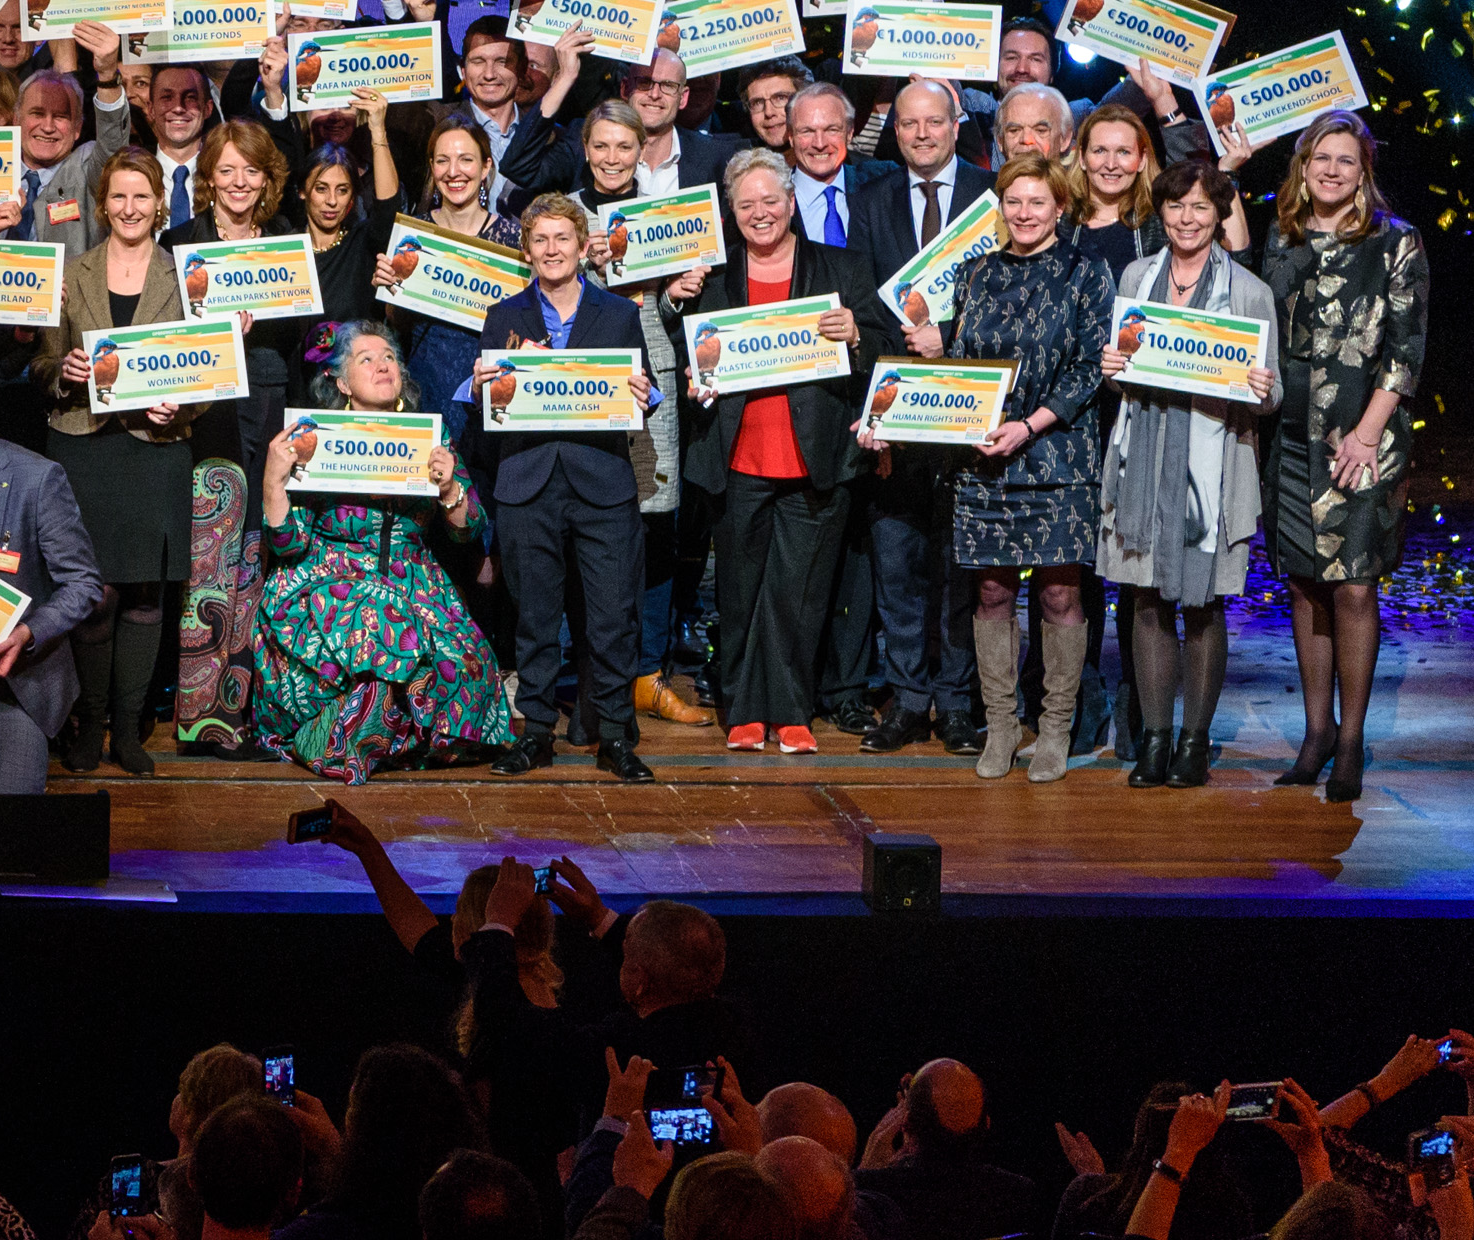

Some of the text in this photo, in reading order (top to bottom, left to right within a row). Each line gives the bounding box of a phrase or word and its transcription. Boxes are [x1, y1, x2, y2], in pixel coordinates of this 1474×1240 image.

[679, 7, 784, 42] €2.250.000,-
[1107, 7, 1196, 52] €500.000,-
[173, 30, 242, 43] ORANJE FONDS
[876, 28, 986, 50] €1.000.000,-
[328, 53, 420, 74] €500.000,-
[373, 72, 432, 86] FOUNDATION
[1240, 68, 1332, 107] €500.000,-
[1262, 86, 1343, 119] WEEKENDSCHOOL
[627, 217, 712, 245] €1.000.000,-
[214, 266, 297, 288] €900.000,-
[207, 288, 312, 305] AFRICAN NETWORK
[1136, 331, 1257, 367] €10.000.000,-
[126, 349, 221, 373] €500.000,-
[718, 349, 837, 374] PLASTIC SOUP FOUNDATION
[1166, 359, 1223, 376] KANSFONDS
[147, 376, 180, 388] WOMEN
[522, 380, 619, 398] €900.000,-
[542, 402, 600, 413] MAMA CASH
[901, 392, 983, 411] €900.000,-
[892, 412, 953, 424] HUMAN RIGHTS
[324, 439, 418, 460] €500.000,-
[339, 463, 421, 475] HUNGER PROJECT
